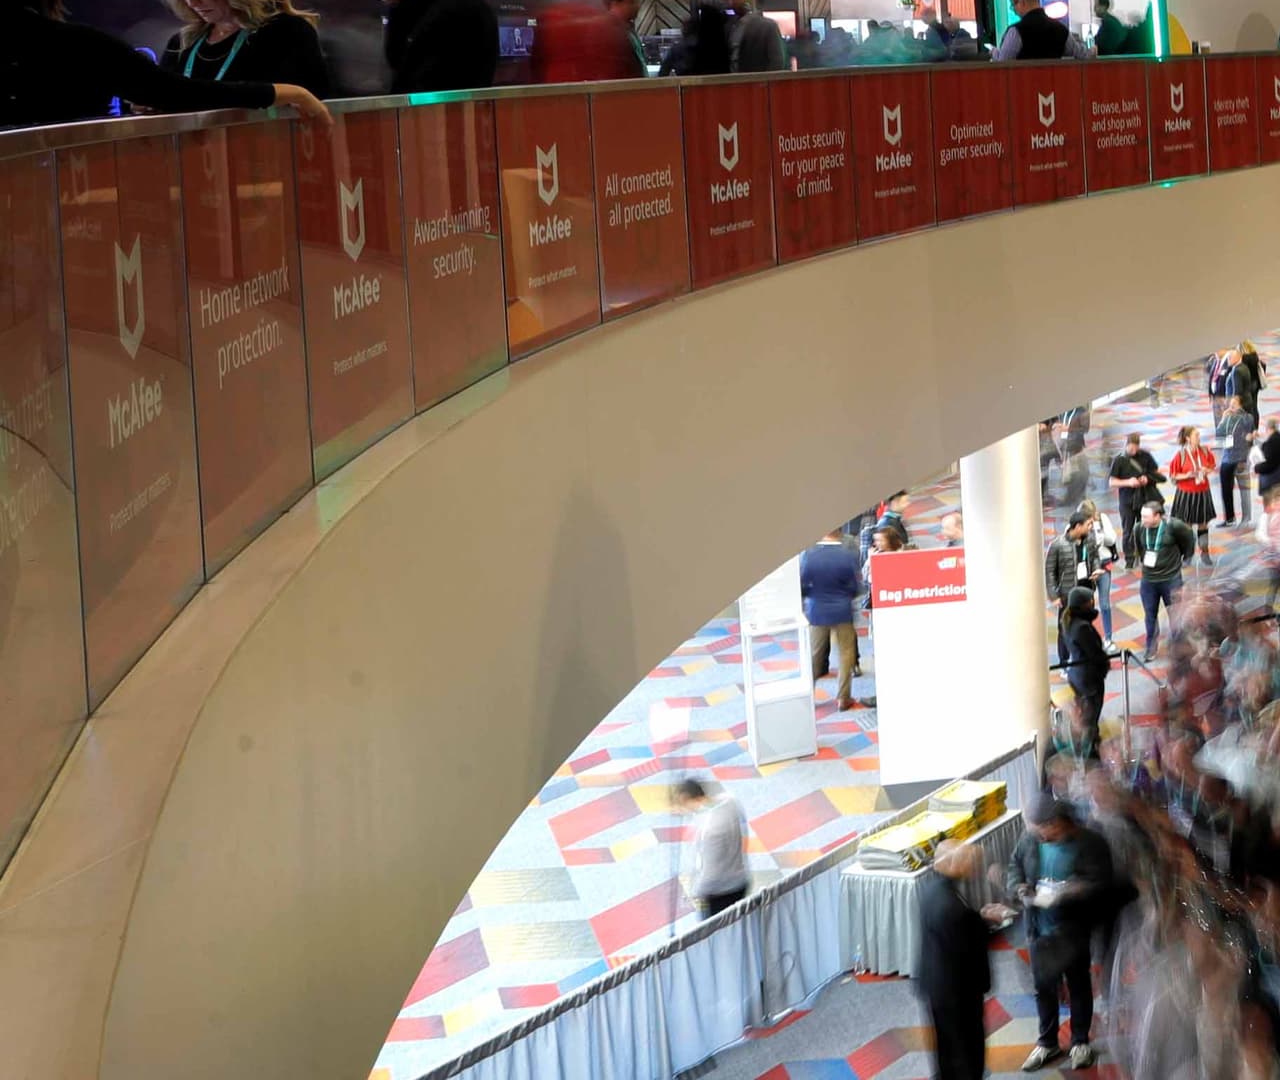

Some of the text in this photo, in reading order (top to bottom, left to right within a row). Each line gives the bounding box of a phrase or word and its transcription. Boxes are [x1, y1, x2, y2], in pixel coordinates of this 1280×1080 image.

[1092, 99, 1139, 116] Browse, bank
[950, 120, 993, 144] Optimized
[1092, 115, 1141, 133] and shop with
[1164, 119, 1191, 133] McAfee
[778, 127, 845, 153] Robust security
[1031, 132, 1064, 150] McAfee
[1097, 132, 1137, 149] confidence.
[782, 153, 844, 179] for your peace
[876, 151, 912, 173] McAfee
[940, 141, 1004, 166] gamer security.
[606, 164, 674, 199] All connected,
[711, 180, 750, 204] McAfee
[797, 175, 833, 198] of mind.
[609, 195, 673, 229] all protected.
[414, 204, 491, 247] Award-winning
[529, 215, 572, 248] McAfee
[433, 243, 477, 279] security.
[201, 256, 289, 328] Home network
[333, 274, 380, 320] McAfee
[217, 320, 283, 389] protection.
[108, 377, 163, 448] McAfee
[879, 590, 902, 602] Bag
